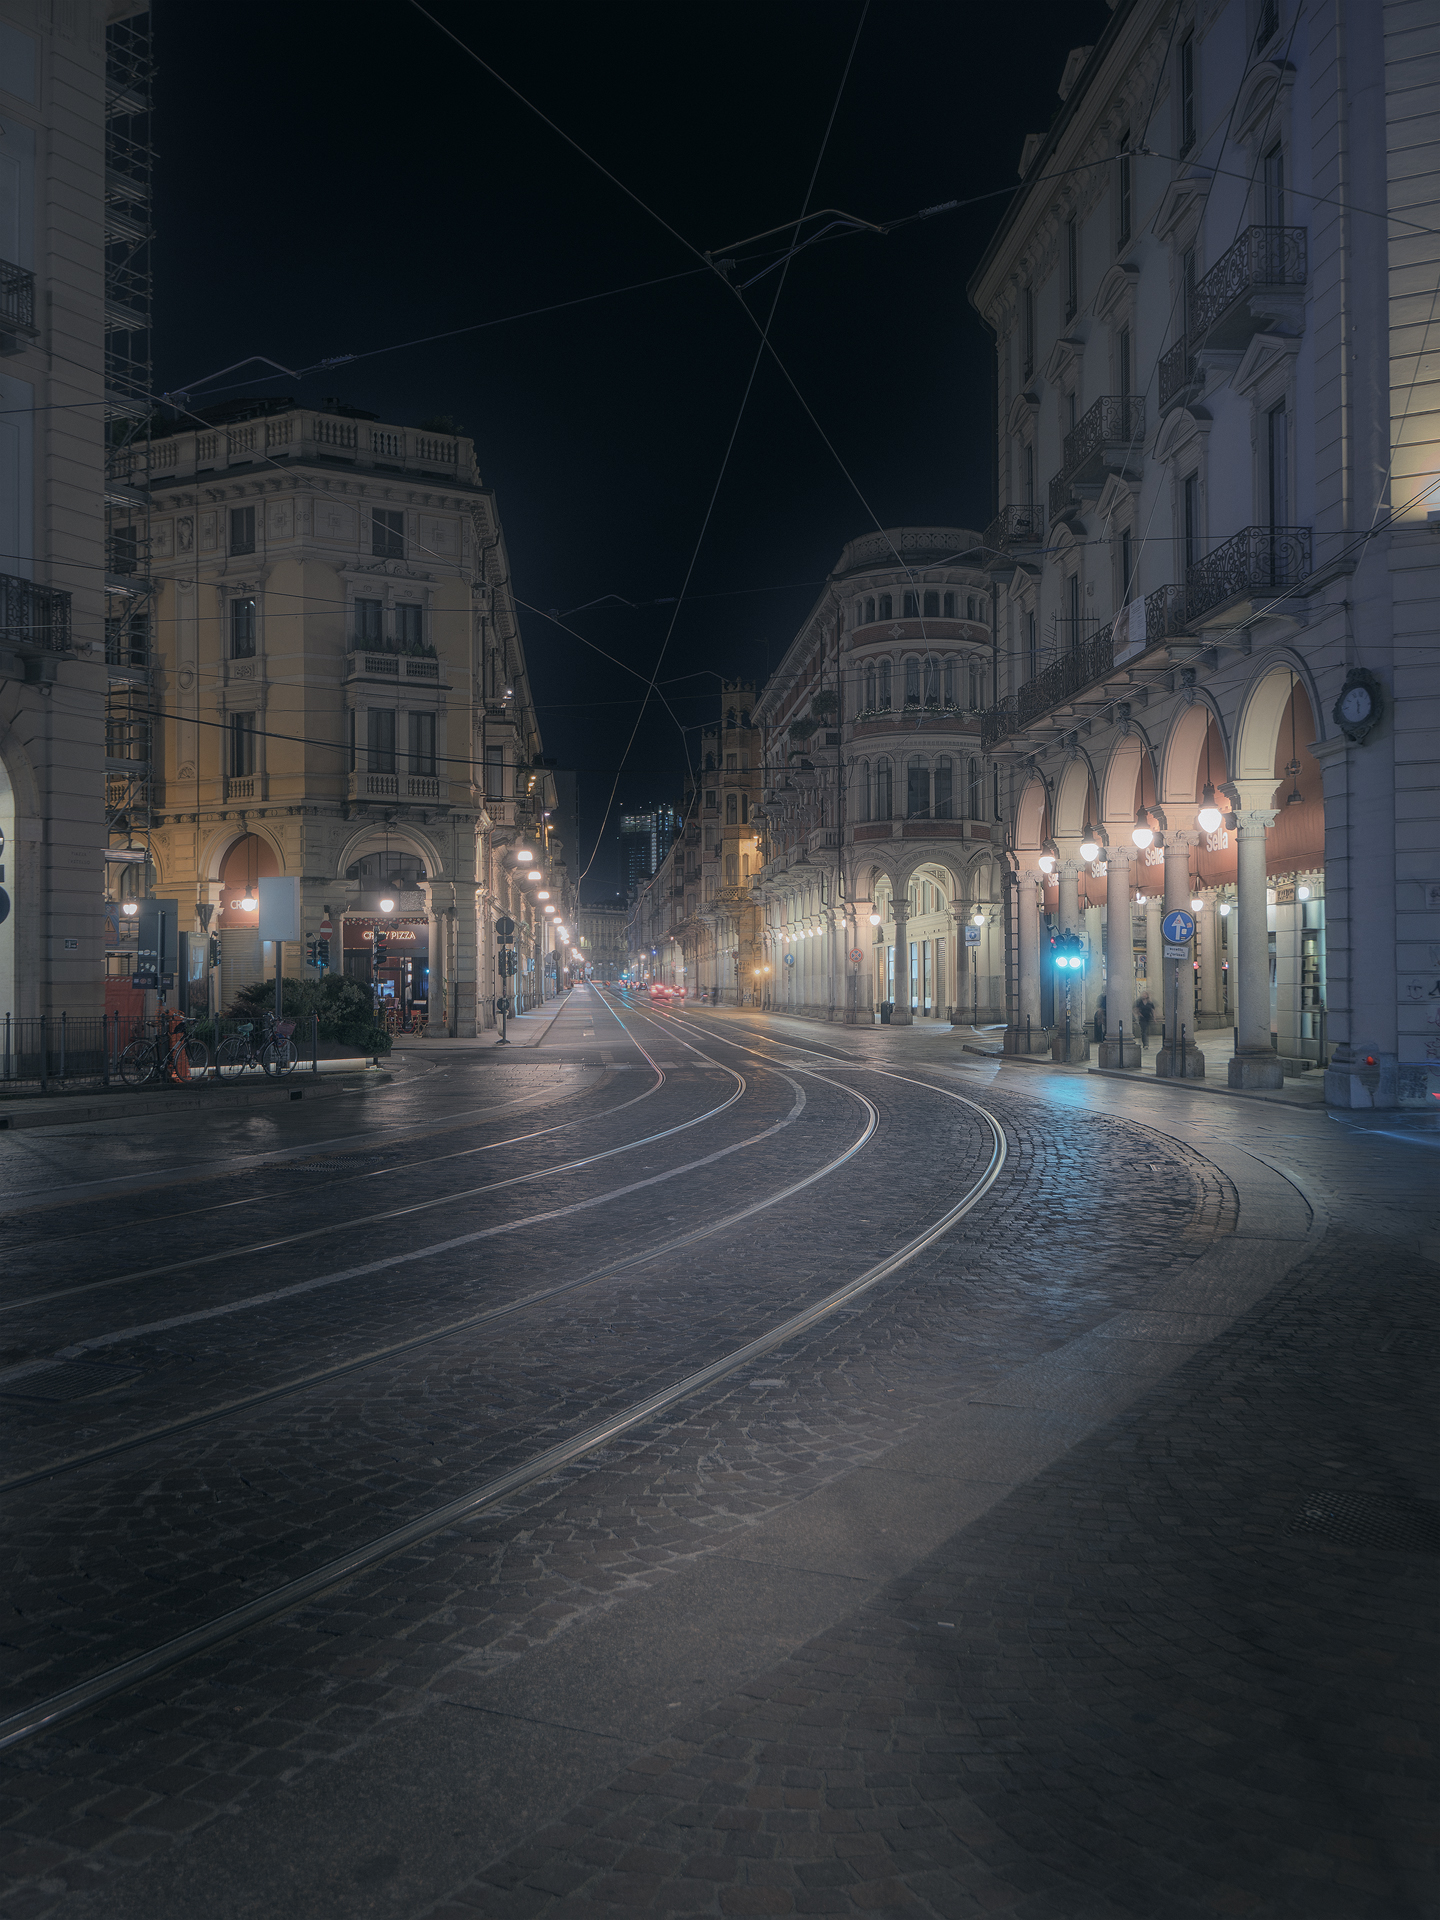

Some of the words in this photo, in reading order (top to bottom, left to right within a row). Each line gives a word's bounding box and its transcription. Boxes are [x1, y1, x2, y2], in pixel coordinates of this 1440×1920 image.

[1206, 828, 1229, 853] Sella
[1145, 846, 1164, 867] Sella
[391, 931, 416, 940] PIZZA
